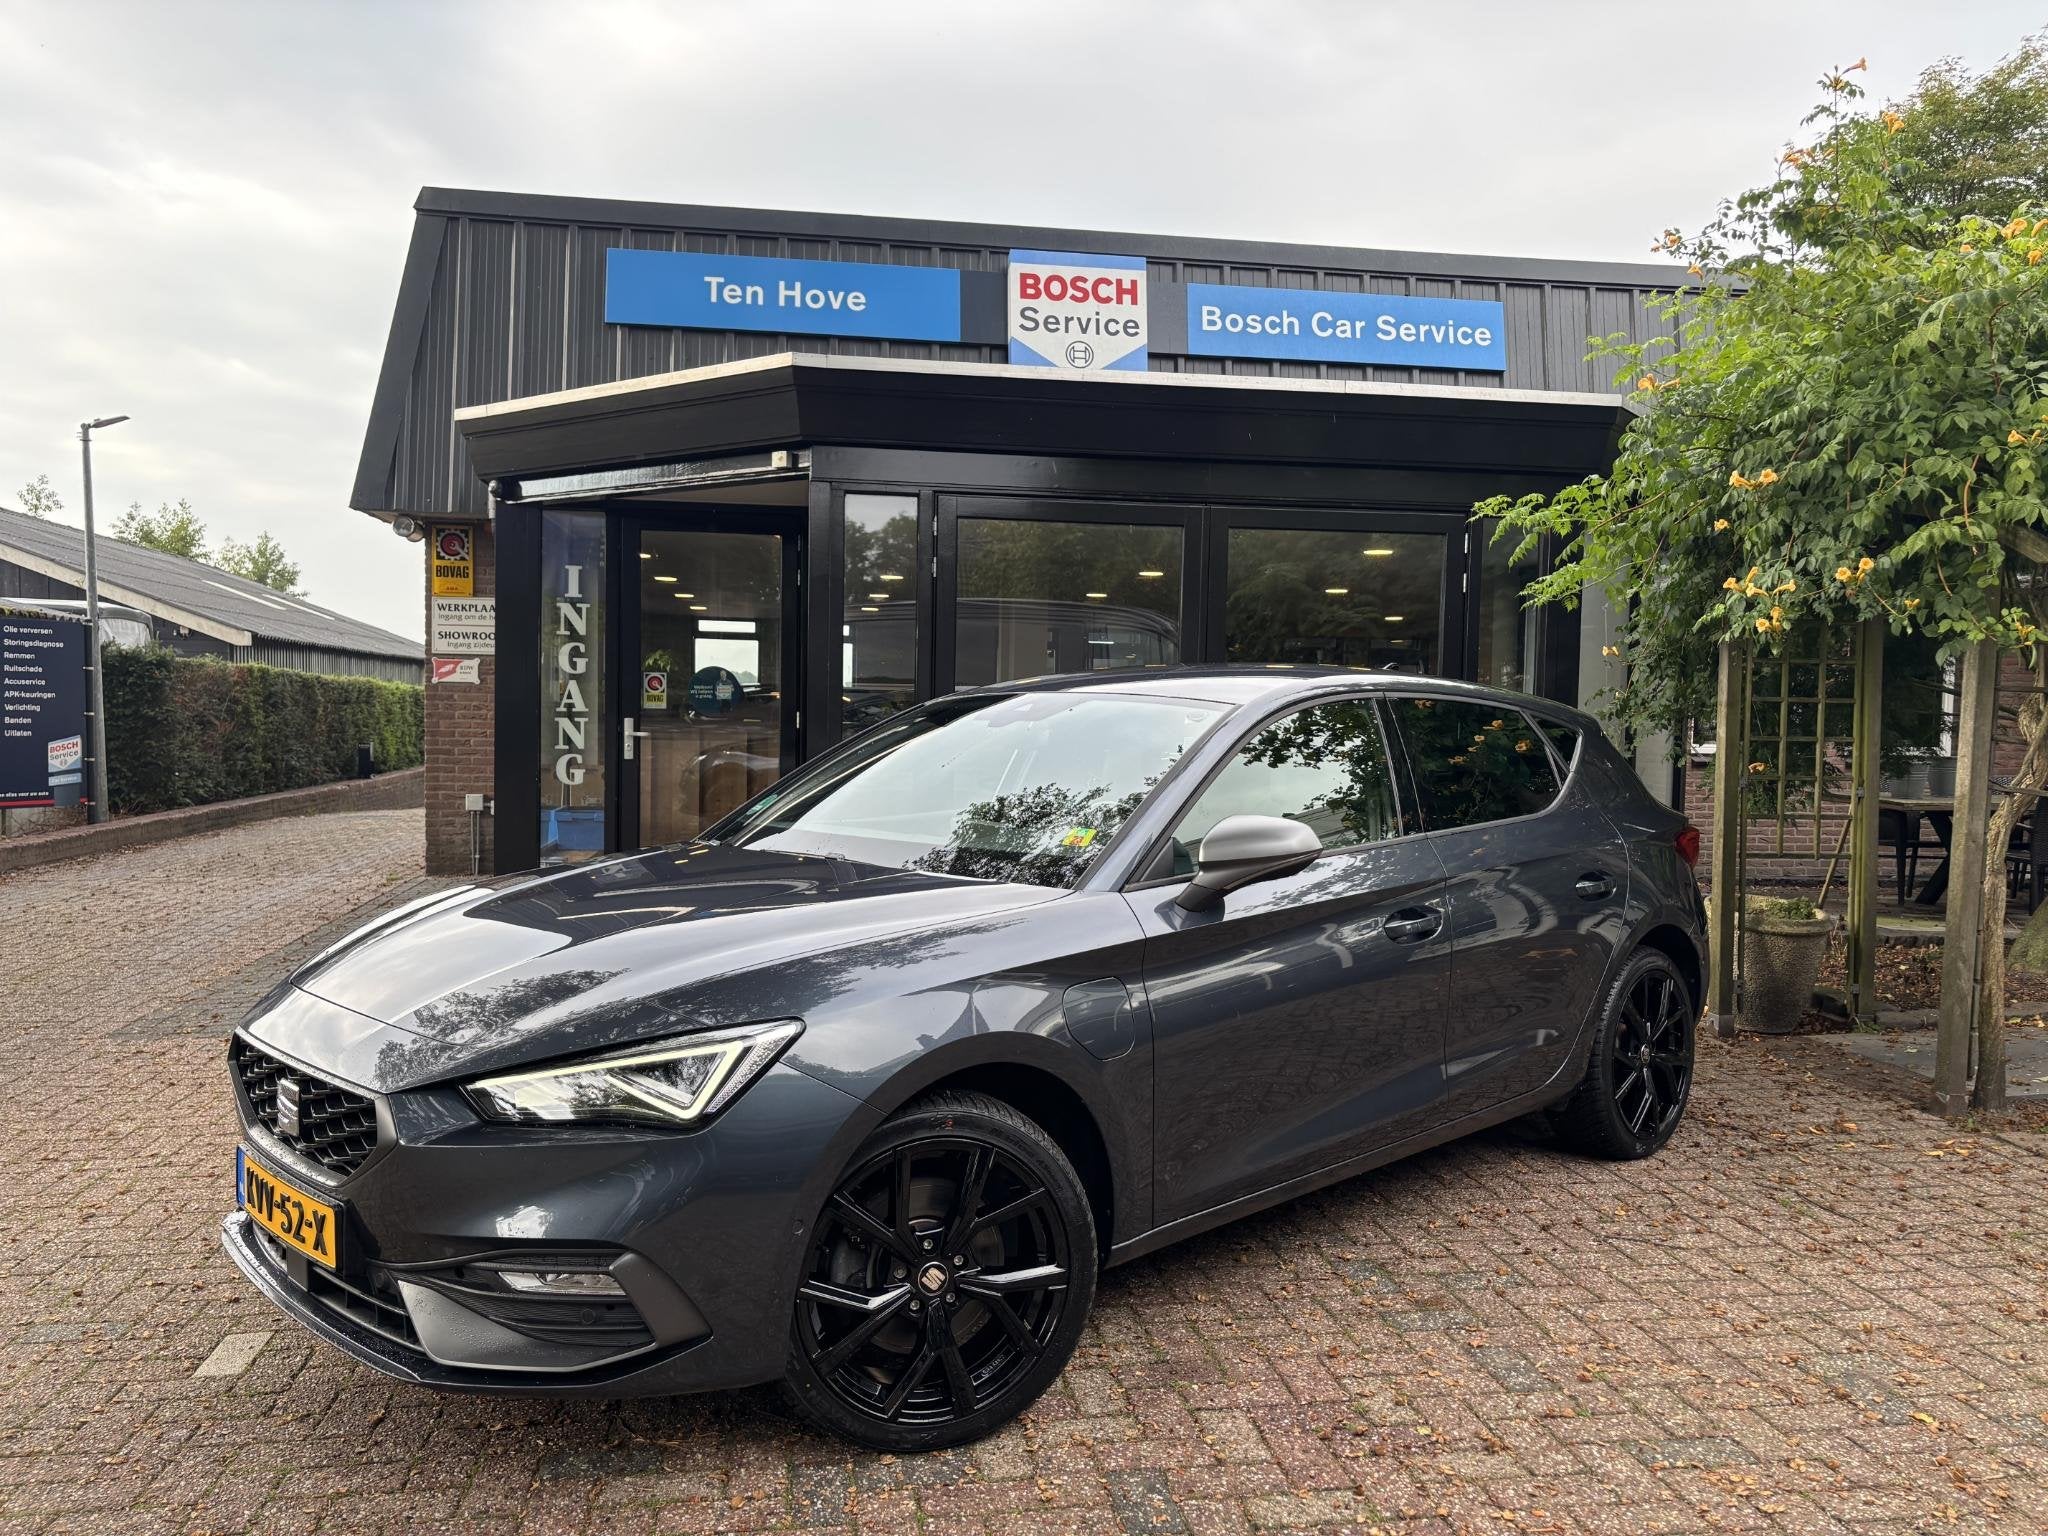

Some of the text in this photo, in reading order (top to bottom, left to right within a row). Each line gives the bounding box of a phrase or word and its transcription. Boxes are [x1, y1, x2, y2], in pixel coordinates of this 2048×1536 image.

[704, 276, 867, 313] Ten Hove
[1019, 273, 1139, 306] BOSCH
[1019, 306, 1140, 338] Service
[1201, 305, 1493, 347] Bosch Car Service
[436, 565, 469, 578] BOVAG
[4, 625, 18, 633] Olie
[4, 639, 64, 648] Storingsdiagnose
[4, 665, 43, 673] Ruitschade
[554, 565, 591, 786] INGANG
[4, 691, 56, 699] APK-keuringen
[4, 704, 41, 712] Verlichting
[4, 729, 32, 737] Uitlaten
[49, 741, 79, 754] BOSCH
[49, 750, 79, 761] Service
